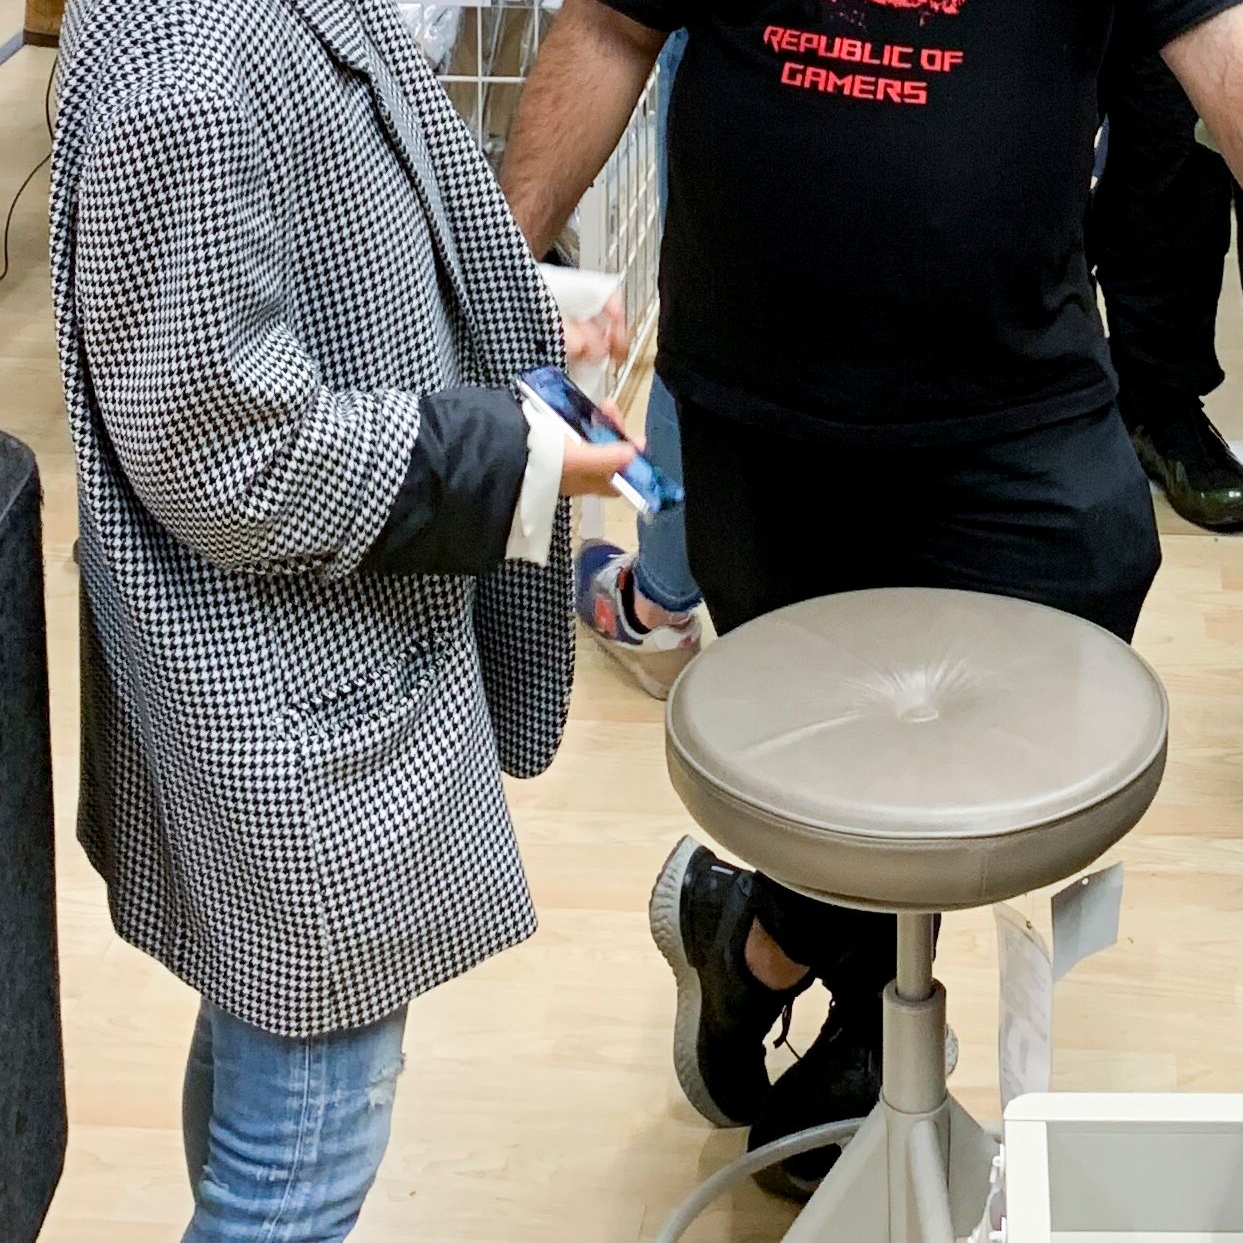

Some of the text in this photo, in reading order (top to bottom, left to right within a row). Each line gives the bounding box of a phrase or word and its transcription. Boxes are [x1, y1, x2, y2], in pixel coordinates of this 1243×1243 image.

[763, 25, 964, 72] REPUBLIC OF
[781, 61, 928, 104] GAMERS
